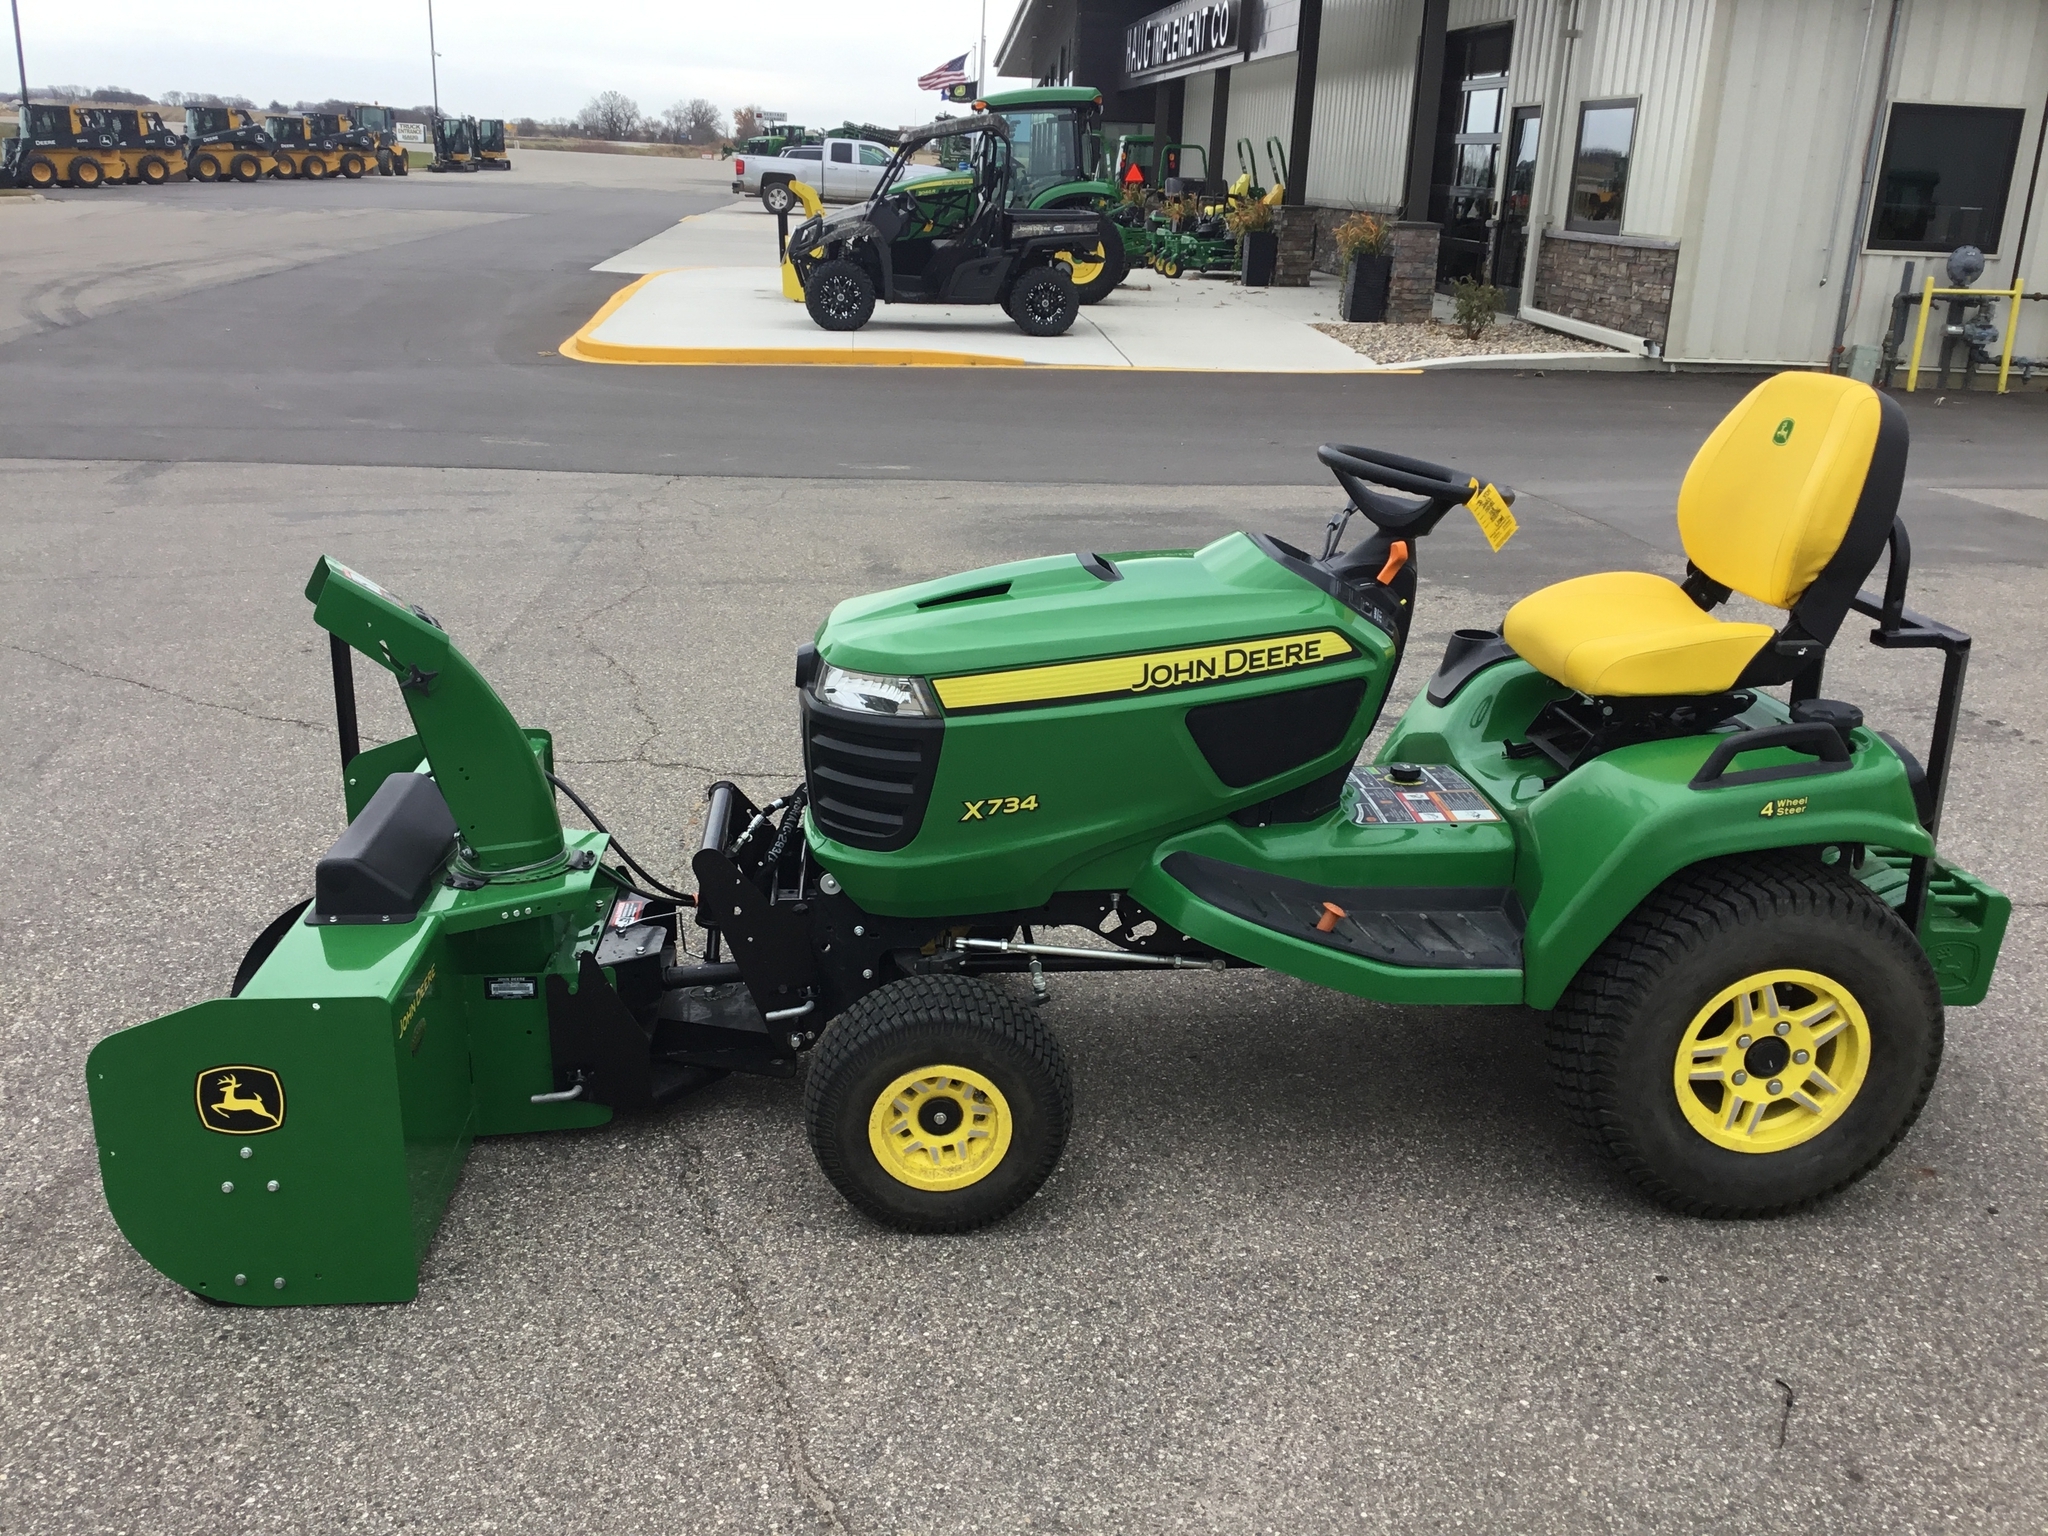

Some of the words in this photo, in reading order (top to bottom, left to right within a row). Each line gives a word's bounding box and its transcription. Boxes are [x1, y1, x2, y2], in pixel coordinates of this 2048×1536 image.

[1125, 20, 1151, 73] HAUG
[1151, 6, 1209, 66] IMPLEMENT
[1211, 0, 1229, 48] CO
[1131, 657, 1216, 690] JOHN
[1224, 639, 1322, 675] DEERE
[959, 794, 1040, 822] X734
[1760, 801, 1774, 817] 4
[1777, 796, 1808, 807] Wheel
[1776, 806, 1807, 816] Steer
[399, 999, 416, 1039] JOHN
[415, 962, 436, 1006] DEERE
